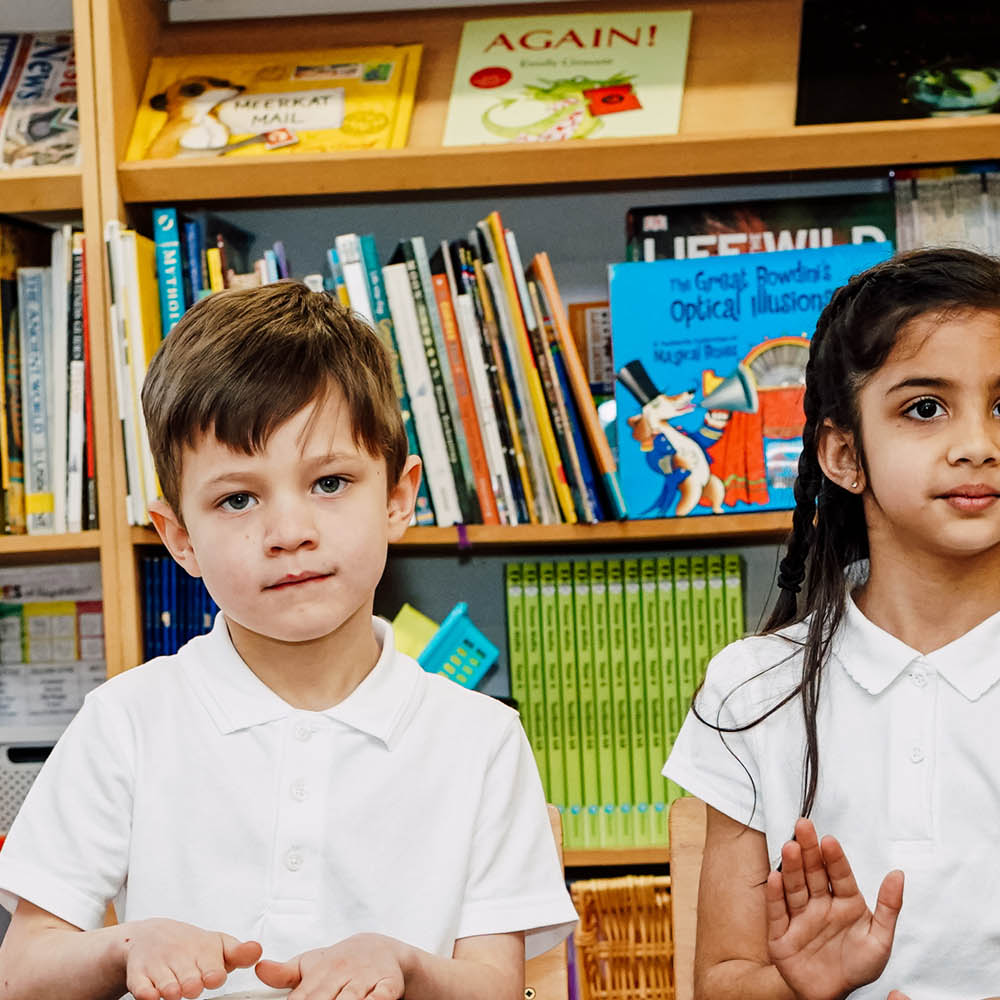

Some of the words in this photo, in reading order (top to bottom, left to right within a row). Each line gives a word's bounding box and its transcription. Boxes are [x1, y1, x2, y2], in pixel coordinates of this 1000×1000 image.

[483, 25, 658, 53] AGAIN!
[16, 41, 72, 101] News
[234, 94, 334, 112] MEERKAT
[251, 112, 305, 126] MAIL
[694, 267, 749, 293] Great
[670, 287, 742, 328] Optical
